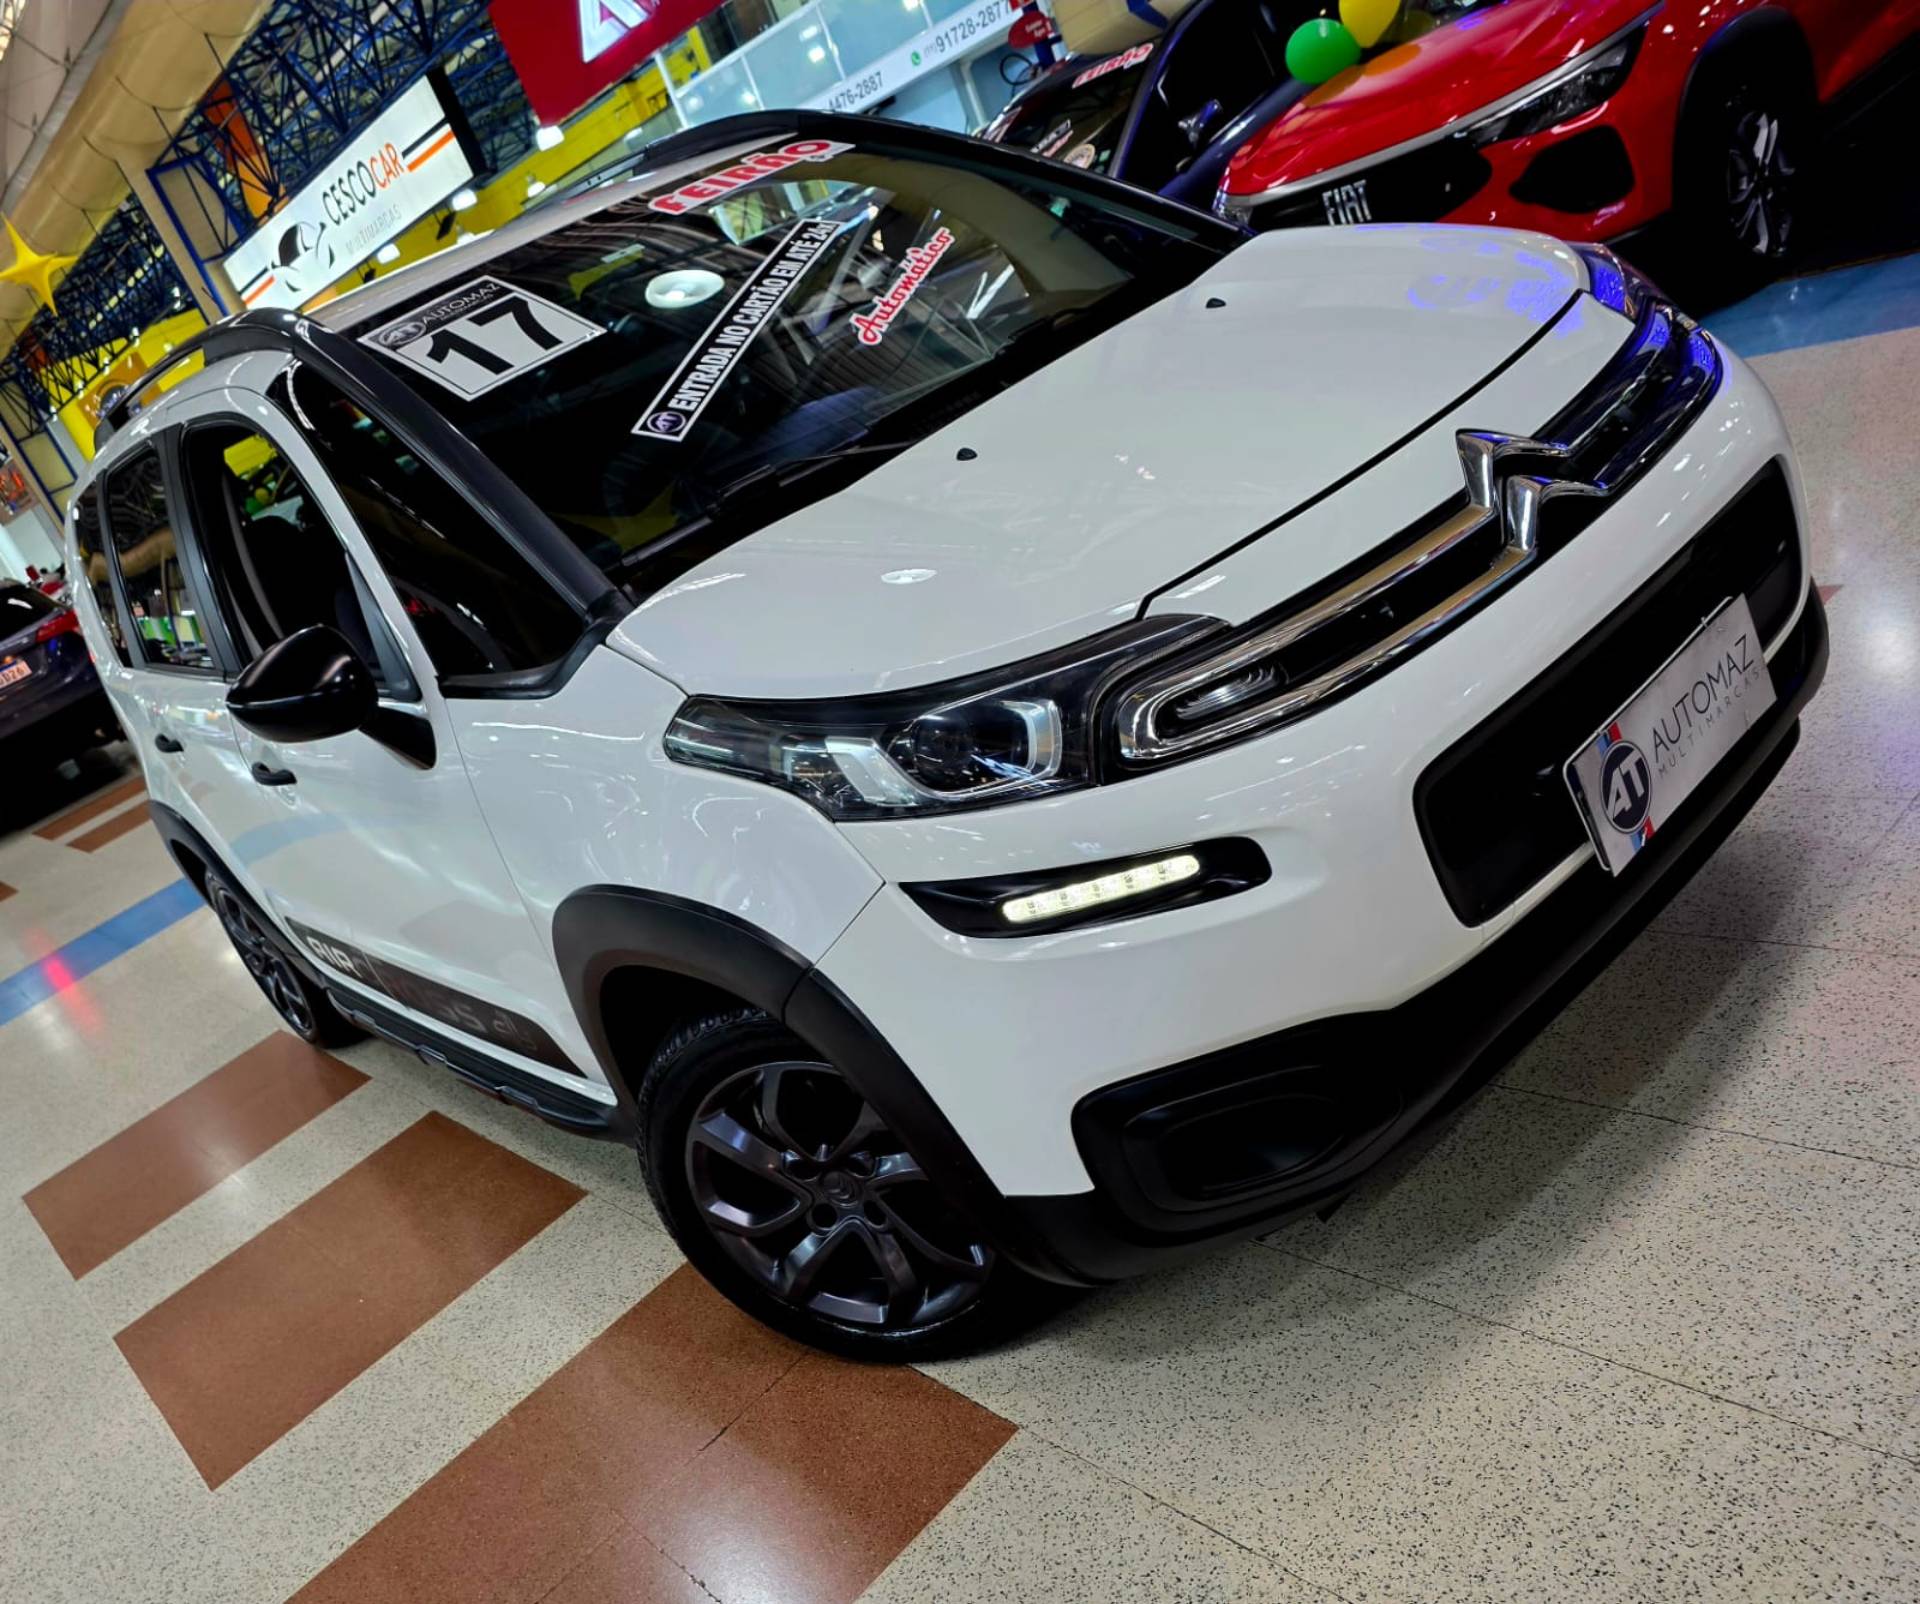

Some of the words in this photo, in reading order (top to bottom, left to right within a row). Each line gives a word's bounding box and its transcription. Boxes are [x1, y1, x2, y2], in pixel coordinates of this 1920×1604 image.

[322, 142, 404, 226] CESCOCAR
[653, 139, 832, 212] FEIRÃO
[1322, 179, 1372, 226] FIAT
[770, 260, 804, 279] EM
[785, 239, 816, 263] ATÉ
[423, 282, 501, 325] AUTOMAZ
[732, 276, 788, 326] CARTÃO
[856, 229, 952, 343] Automático
[427, 296, 563, 375] 17
[716, 325, 751, 348] NO
[668, 347, 737, 412] ENTRADA
[1651, 633, 1755, 764] AUTOMAZ
[1658, 670, 1761, 779] MULTIMARCAS
